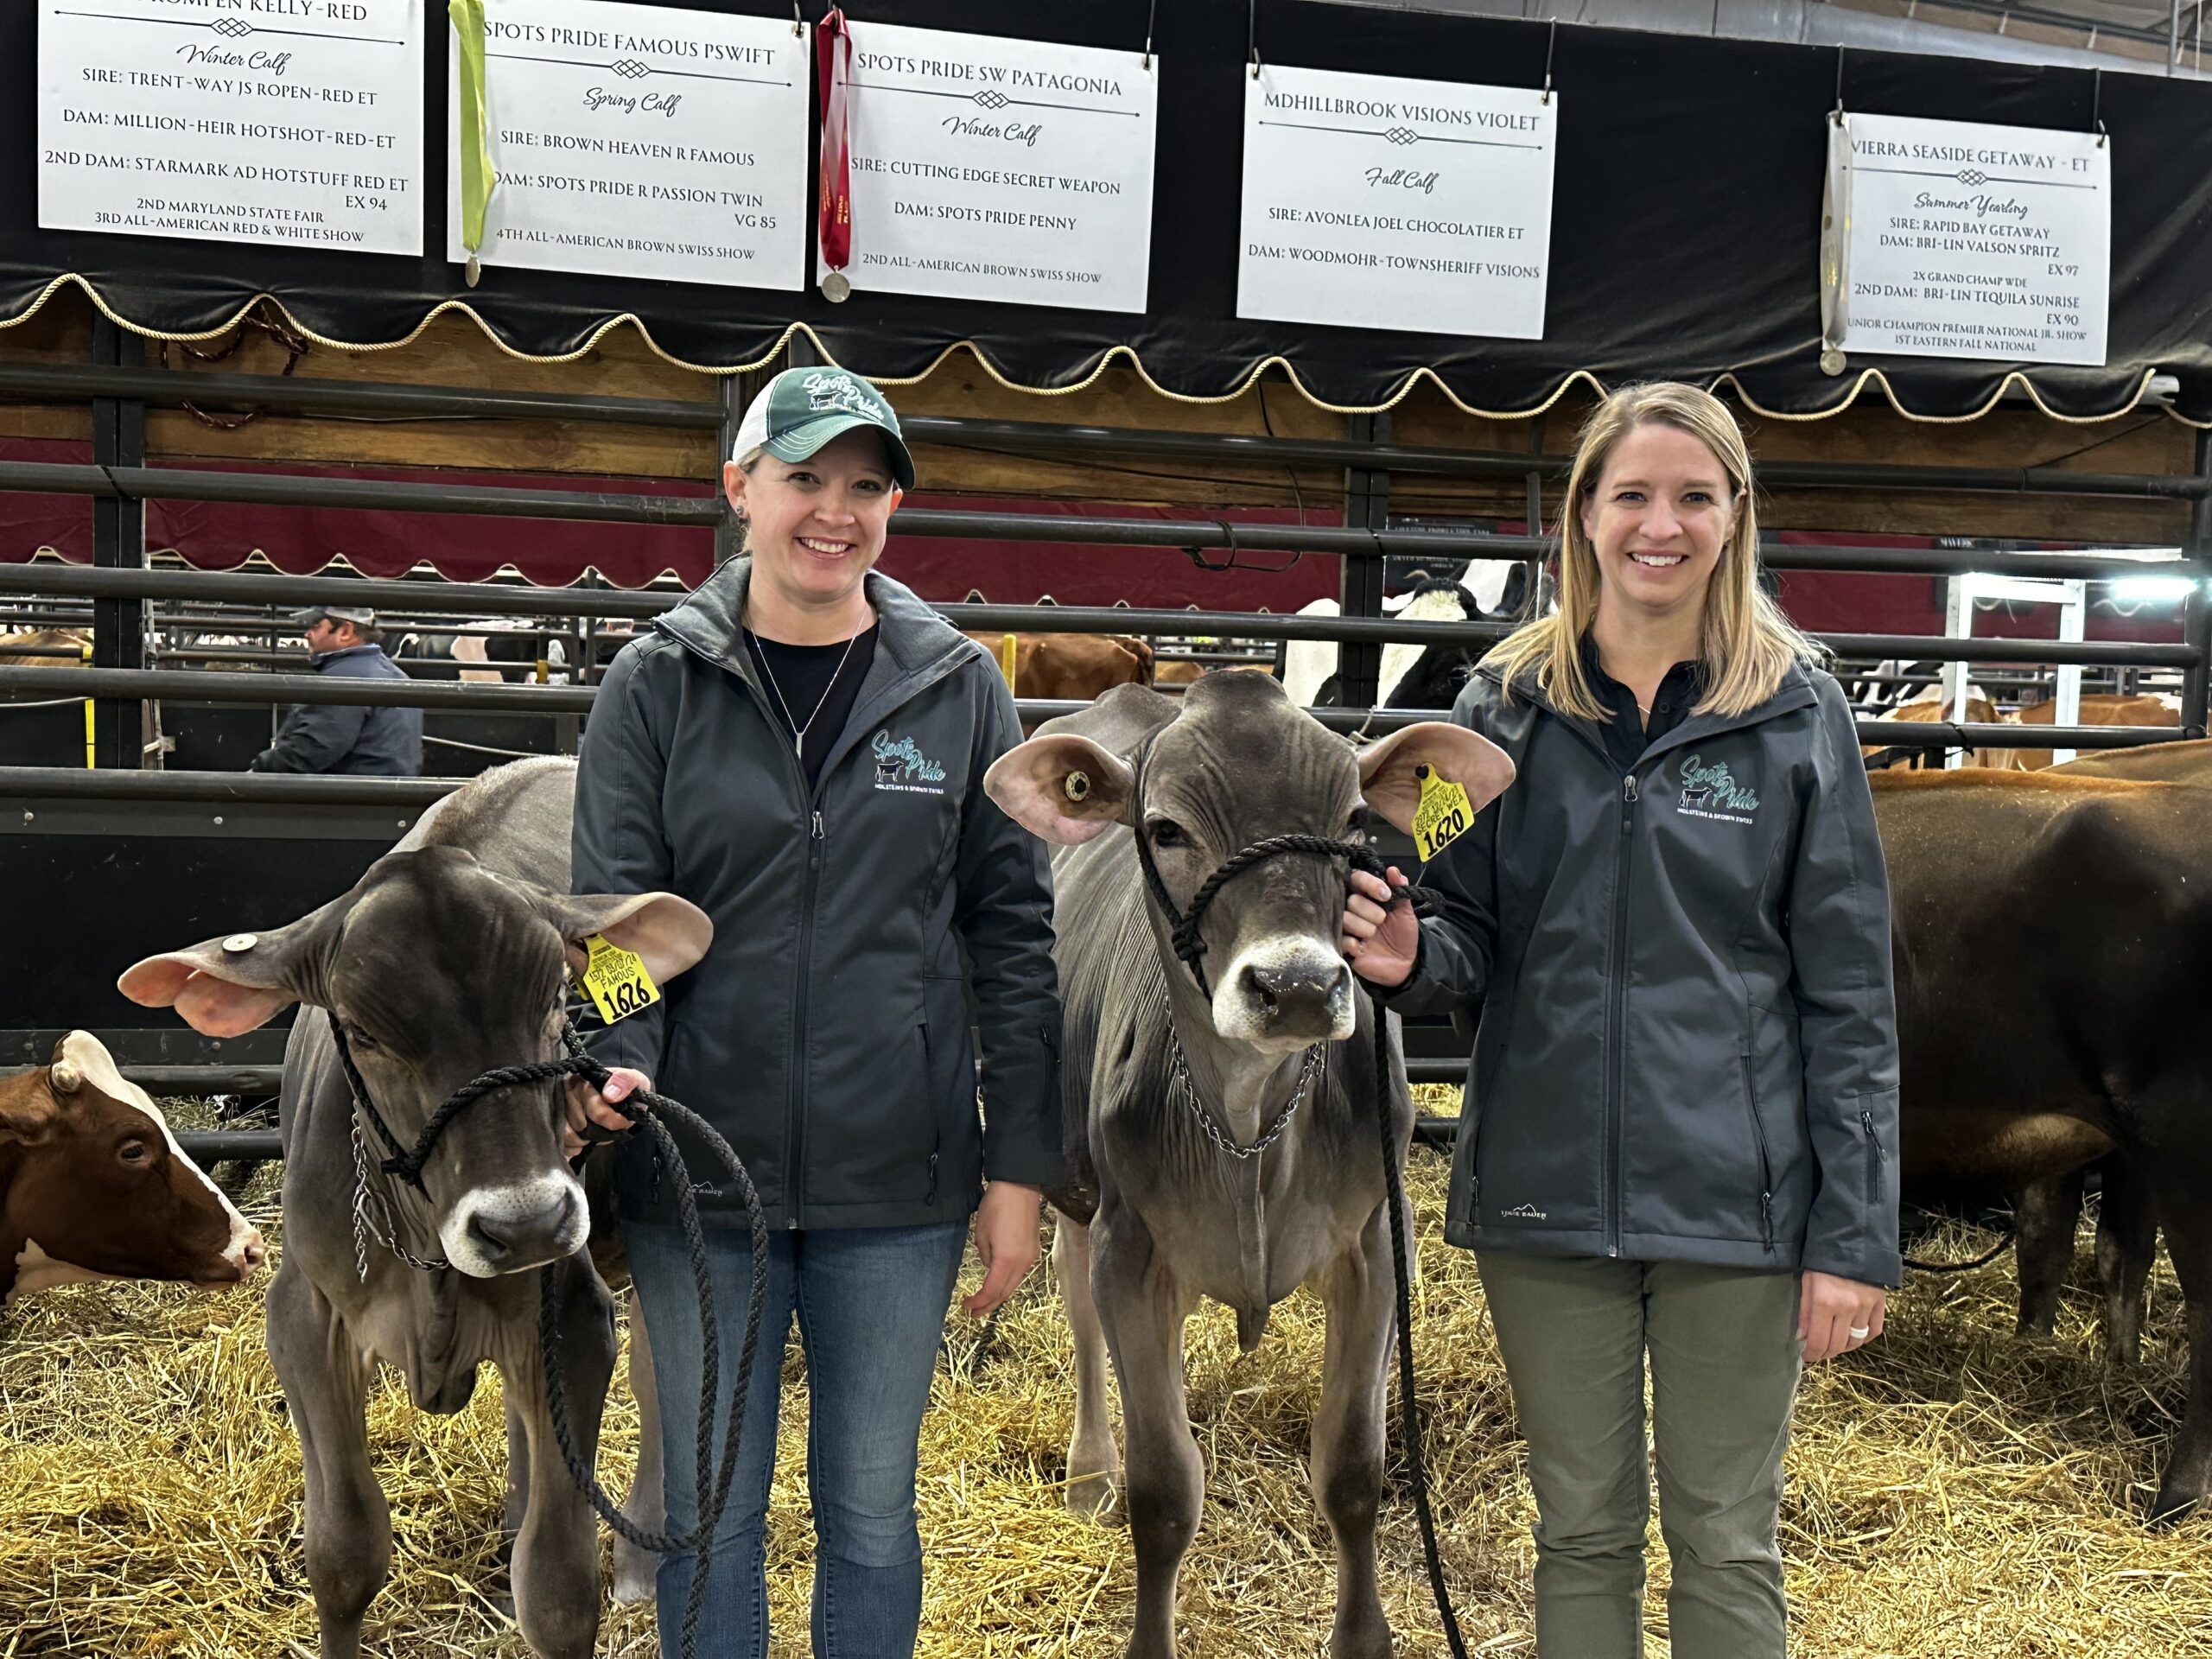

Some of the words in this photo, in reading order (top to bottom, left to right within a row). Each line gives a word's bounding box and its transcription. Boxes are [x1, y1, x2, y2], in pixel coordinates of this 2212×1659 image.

[250, 0, 367, 21] KELLY-RED
[175, 43, 245, 67] Winter
[248, 50, 292, 77] Calf
[483, 22, 545, 42] SPOTS
[551, 27, 609, 48] PRIDE
[614, 34, 698, 57] FAMOUS
[704, 43, 776, 66] PSWIFT
[82, 67, 124, 84] SIRE:
[127, 71, 233, 93] TRENT-WAY
[238, 80, 252, 97] JS
[257, 82, 354, 104] ROPEN-RED
[358, 92, 378, 105] ET
[857, 52, 915, 73] SPOTS
[921, 59, 975, 80] PRIDE
[978, 66, 1007, 83] SW
[1012, 69, 1122, 96] PATAGONIA
[582, 86, 637, 115] Spring
[640, 92, 683, 118] Calf
[1264, 92, 1397, 119] MDHILLBROOK
[1402, 105, 1472, 125] VISIONS
[1477, 111, 1541, 131] VIOLET
[63, 108, 109, 125] DAM:
[113, 113, 237, 136] MILLION-HEIR
[241, 123, 397, 149] HOTSHOT-RED-ET
[941, 116, 1001, 138] Winter
[1003, 123, 1043, 148] Calf
[500, 130, 539, 146] SIRE:
[543, 134, 604, 152] BROWN
[608, 140, 672, 159] HEAVEN
[677, 146, 687, 161] R
[690, 148, 754, 167] FAMOUS
[1851, 139, 1909, 157] VIERRA
[1911, 144, 1974, 162] SEASIDE
[1977, 149, 2055, 169] GETAWAY
[2072, 157, 2088, 172] ET
[45, 149, 81, 165] 2ND
[85, 153, 130, 169] DAM:
[135, 156, 229, 177] STARMARK
[232, 165, 257, 179] AD
[262, 167, 349, 187] HOTSTUFF
[353, 175, 385, 190] RED
[389, 177, 409, 192] ET
[850, 156, 887, 173] SIRE:
[890, 161, 959, 180] CUTTING
[963, 168, 1001, 184] EDGE
[1002, 172, 1056, 189] SECRET
[1058, 176, 1121, 195] WEAPON
[1364, 167, 1403, 188] Fall
[1402, 171, 1440, 195] Calf
[345, 194, 365, 210] EX
[369, 197, 388, 211] 94
[537, 175, 586, 192] SPOTS
[589, 180, 634, 197] PRIDE
[638, 184, 648, 198] R
[652, 185, 716, 203] PASSION
[720, 192, 763, 208] TWIN
[137, 197, 166, 211] 2ND
[168, 200, 247, 217] MARYLAND
[249, 207, 292, 220] STATE
[294, 210, 325, 223] FAIR
[734, 213, 756, 228] VG
[760, 215, 776, 229] 85
[894, 201, 934, 218] DAM:
[937, 206, 982, 222] SPOTS
[985, 209, 1027, 226] PRIDE
[1029, 213, 1077, 231] PENNY
[1268, 207, 1302, 222] SIRE:
[1304, 210, 1370, 228] AVONLEA
[1372, 216, 1404, 231] JOEL
[1406, 219, 1505, 239] CHOCOLATIER
[1508, 226, 1525, 240] ET
[94, 212, 122, 225] 3RD
[124, 214, 229, 232] ALL-AMERICAN
[232, 221, 259, 235] RED
[261, 224, 271, 236] &
[274, 225, 321, 239] WHITE
[322, 229, 365, 243] SHOW
[1890, 217, 1920, 231] SIRE:
[1923, 219, 1961, 233] RAPID
[1962, 221, 1987, 236] BAY
[1988, 224, 2050, 240] GETAWAY
[496, 228, 523, 241] 4TH
[525, 231, 624, 249] ALL-AMERICAN
[627, 238, 675, 253] BROWN
[677, 244, 714, 257] SWISS
[715, 247, 755, 260] SHOW
[1879, 233, 1914, 248] DAM:
[1916, 236, 1964, 251] BRI-LIN
[1966, 239, 2017, 255] VALSON
[2018, 244, 2060, 258] SPRITZ
[862, 253, 888, 265] 2ND
[889, 256, 981, 273] ALL-AMERICAN
[983, 264, 1028, 277] BROWN
[1029, 268, 1064, 281] SWISS
[1065, 270, 1102, 283] SHOW
[1249, 244, 1286, 259] DAM:
[1485, 263, 1540, 279] VISIONS
[2048, 263, 2063, 276] EX
[1912, 270, 1926, 282] 2X
[1927, 270, 1965, 283] GRAND
[1965, 275, 2004, 287] CHAMP
[1854, 283, 1882, 296] 2ND
[1884, 284, 1918, 298] DAM:
[1923, 287, 1972, 302] BRI-LIN
[1974, 290, 2027, 306] TEQUILA
[2029, 294, 2080, 309] SUNRISE
[1847, 317, 1881, 329] UNIOR
[2046, 313, 2062, 326] EX
[872, 729, 914, 762] Spots
[906, 749, 946, 781] Pride
[1680, 754, 1728, 788] Spots
[1712, 776, 1759, 810] Pride
[1423, 808, 1464, 857] 1620
[601, 967, 635, 989] FAMOUS
[602, 976, 651, 1020] 1626
